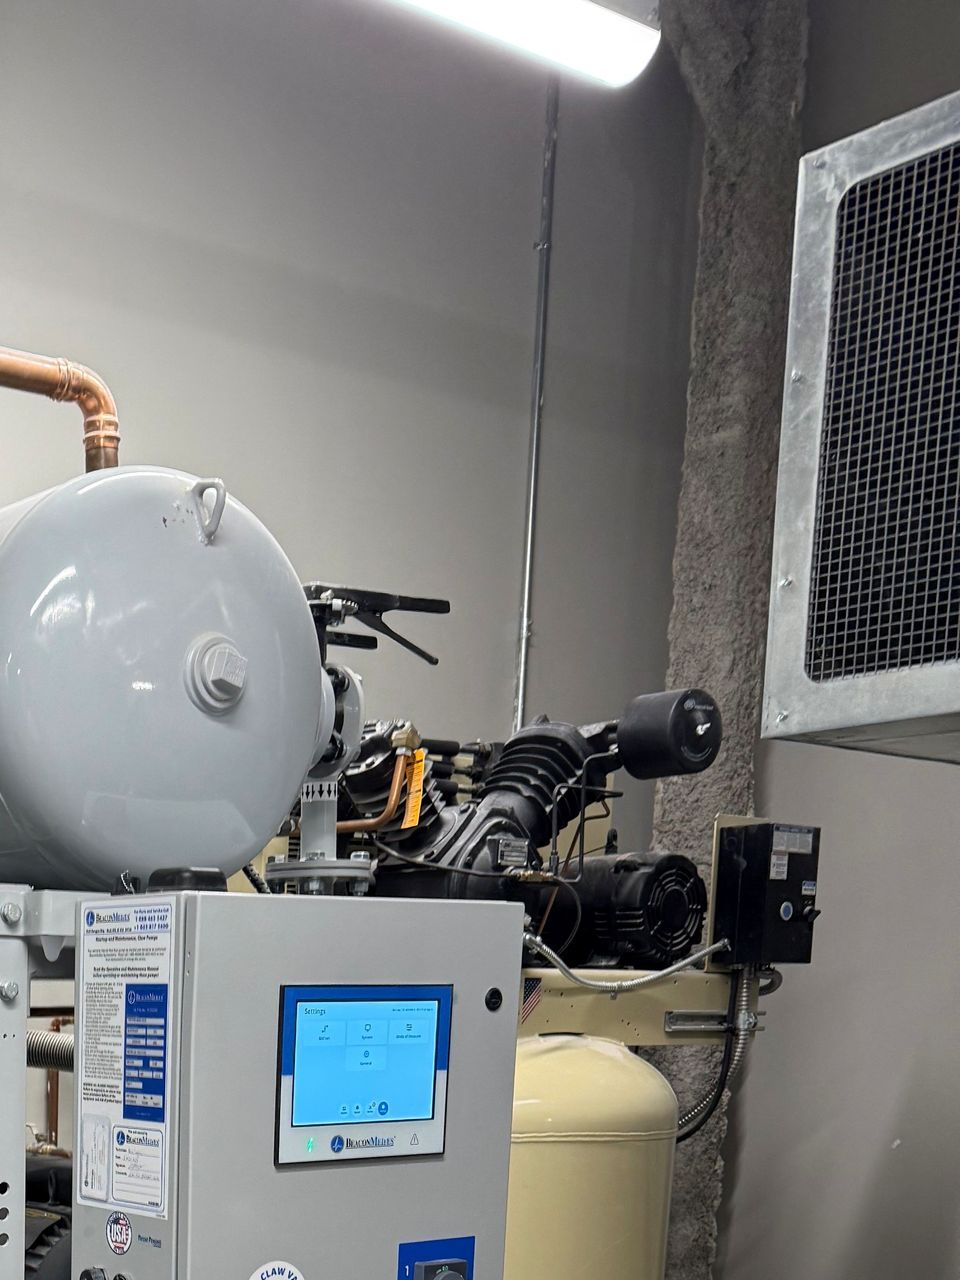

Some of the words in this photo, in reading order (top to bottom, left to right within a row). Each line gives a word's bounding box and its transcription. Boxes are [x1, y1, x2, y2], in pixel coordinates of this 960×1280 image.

[304, 1008, 326, 1016] Settings
[111, 1223, 126, 1243] USA
[260, 1267, 286, 1280] CLAW
[405, 1265, 409, 1276] 1
